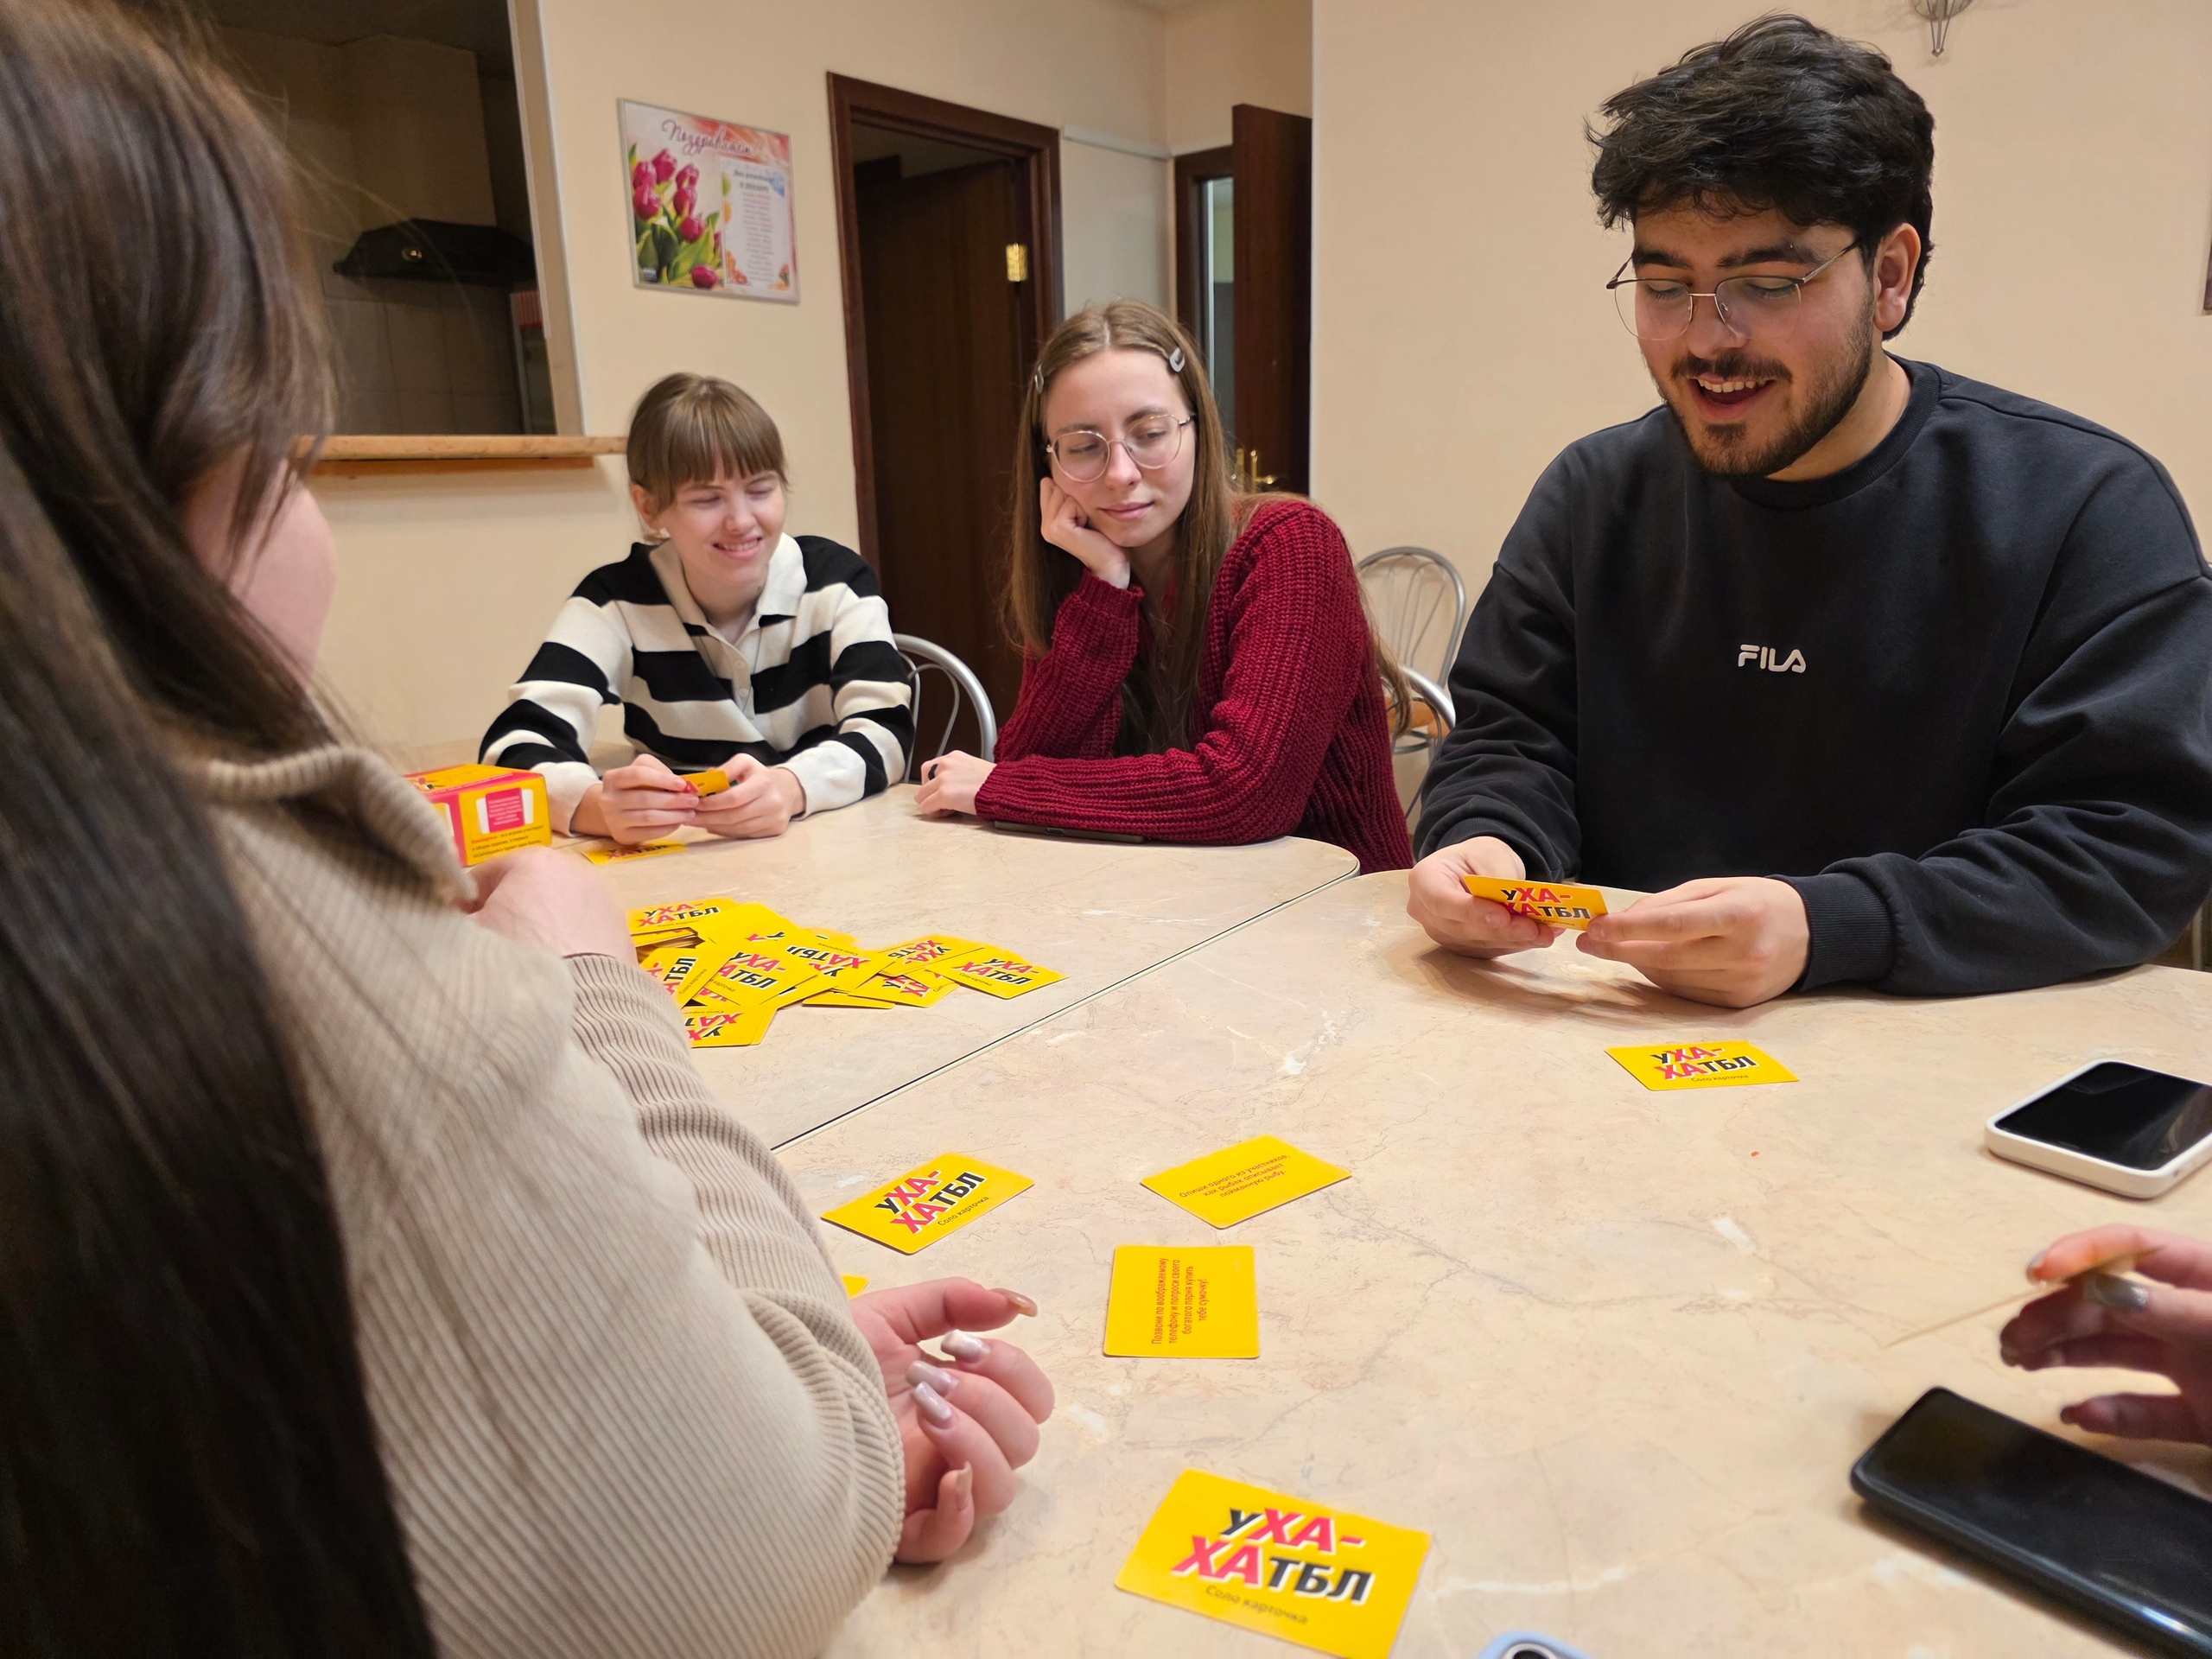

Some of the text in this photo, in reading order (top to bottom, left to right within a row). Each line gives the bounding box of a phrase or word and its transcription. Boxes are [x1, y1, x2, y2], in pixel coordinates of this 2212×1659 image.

[1738, 644, 1807, 674] FILA
[1500, 887, 1571, 904] УХА-
[636, 906, 720, 928] ХАТБЛ
[644, 903, 704, 917] УХА-
[729, 951, 786, 972] УХА-
[786, 946, 871, 969] ХАТБЛ
[887, 940, 944, 958] ХАТБ
[662, 957, 697, 995] АТБЛ
[718, 964, 778, 988] АТБЛ
[951, 962, 1033, 984] ХАТБЛ
[982, 958, 1040, 974] УХА-
[1649, 1046, 1723, 1065] УХА-
[1653, 1056, 1757, 1080] ХАТБЛ
[1179, 1185, 1209, 1198] Опиши
[1208, 1174, 1236, 1187] одного
[1218, 1179, 1244, 1192] рыбак
[1243, 1163, 1284, 1181] описывает
[1219, 1170, 1287, 1198] пойманную рыбу.
[874, 1170, 939, 1214] УХА-
[890, 1172, 985, 1235] ХАТБЛ
[938, 1196, 989, 1226] Соло карточка
[1155, 1257, 1170, 1306] воображаемому
[1172, 1259, 1180, 1279] своего
[1171, 1280, 1182, 1305] попроси
[1181, 1266, 1196, 1334] богатого парня купить
[1197, 1279, 1210, 1321] тебе сумочку!
[1151, 1316, 1163, 1344] Позвони
[1167, 1311, 1181, 1344] телефону
[1219, 1507, 1365, 1553] УХА-
[1170, 1535, 1374, 1602] ХАТБЛ
[1205, 1585, 1308, 1624] Соло карточка
